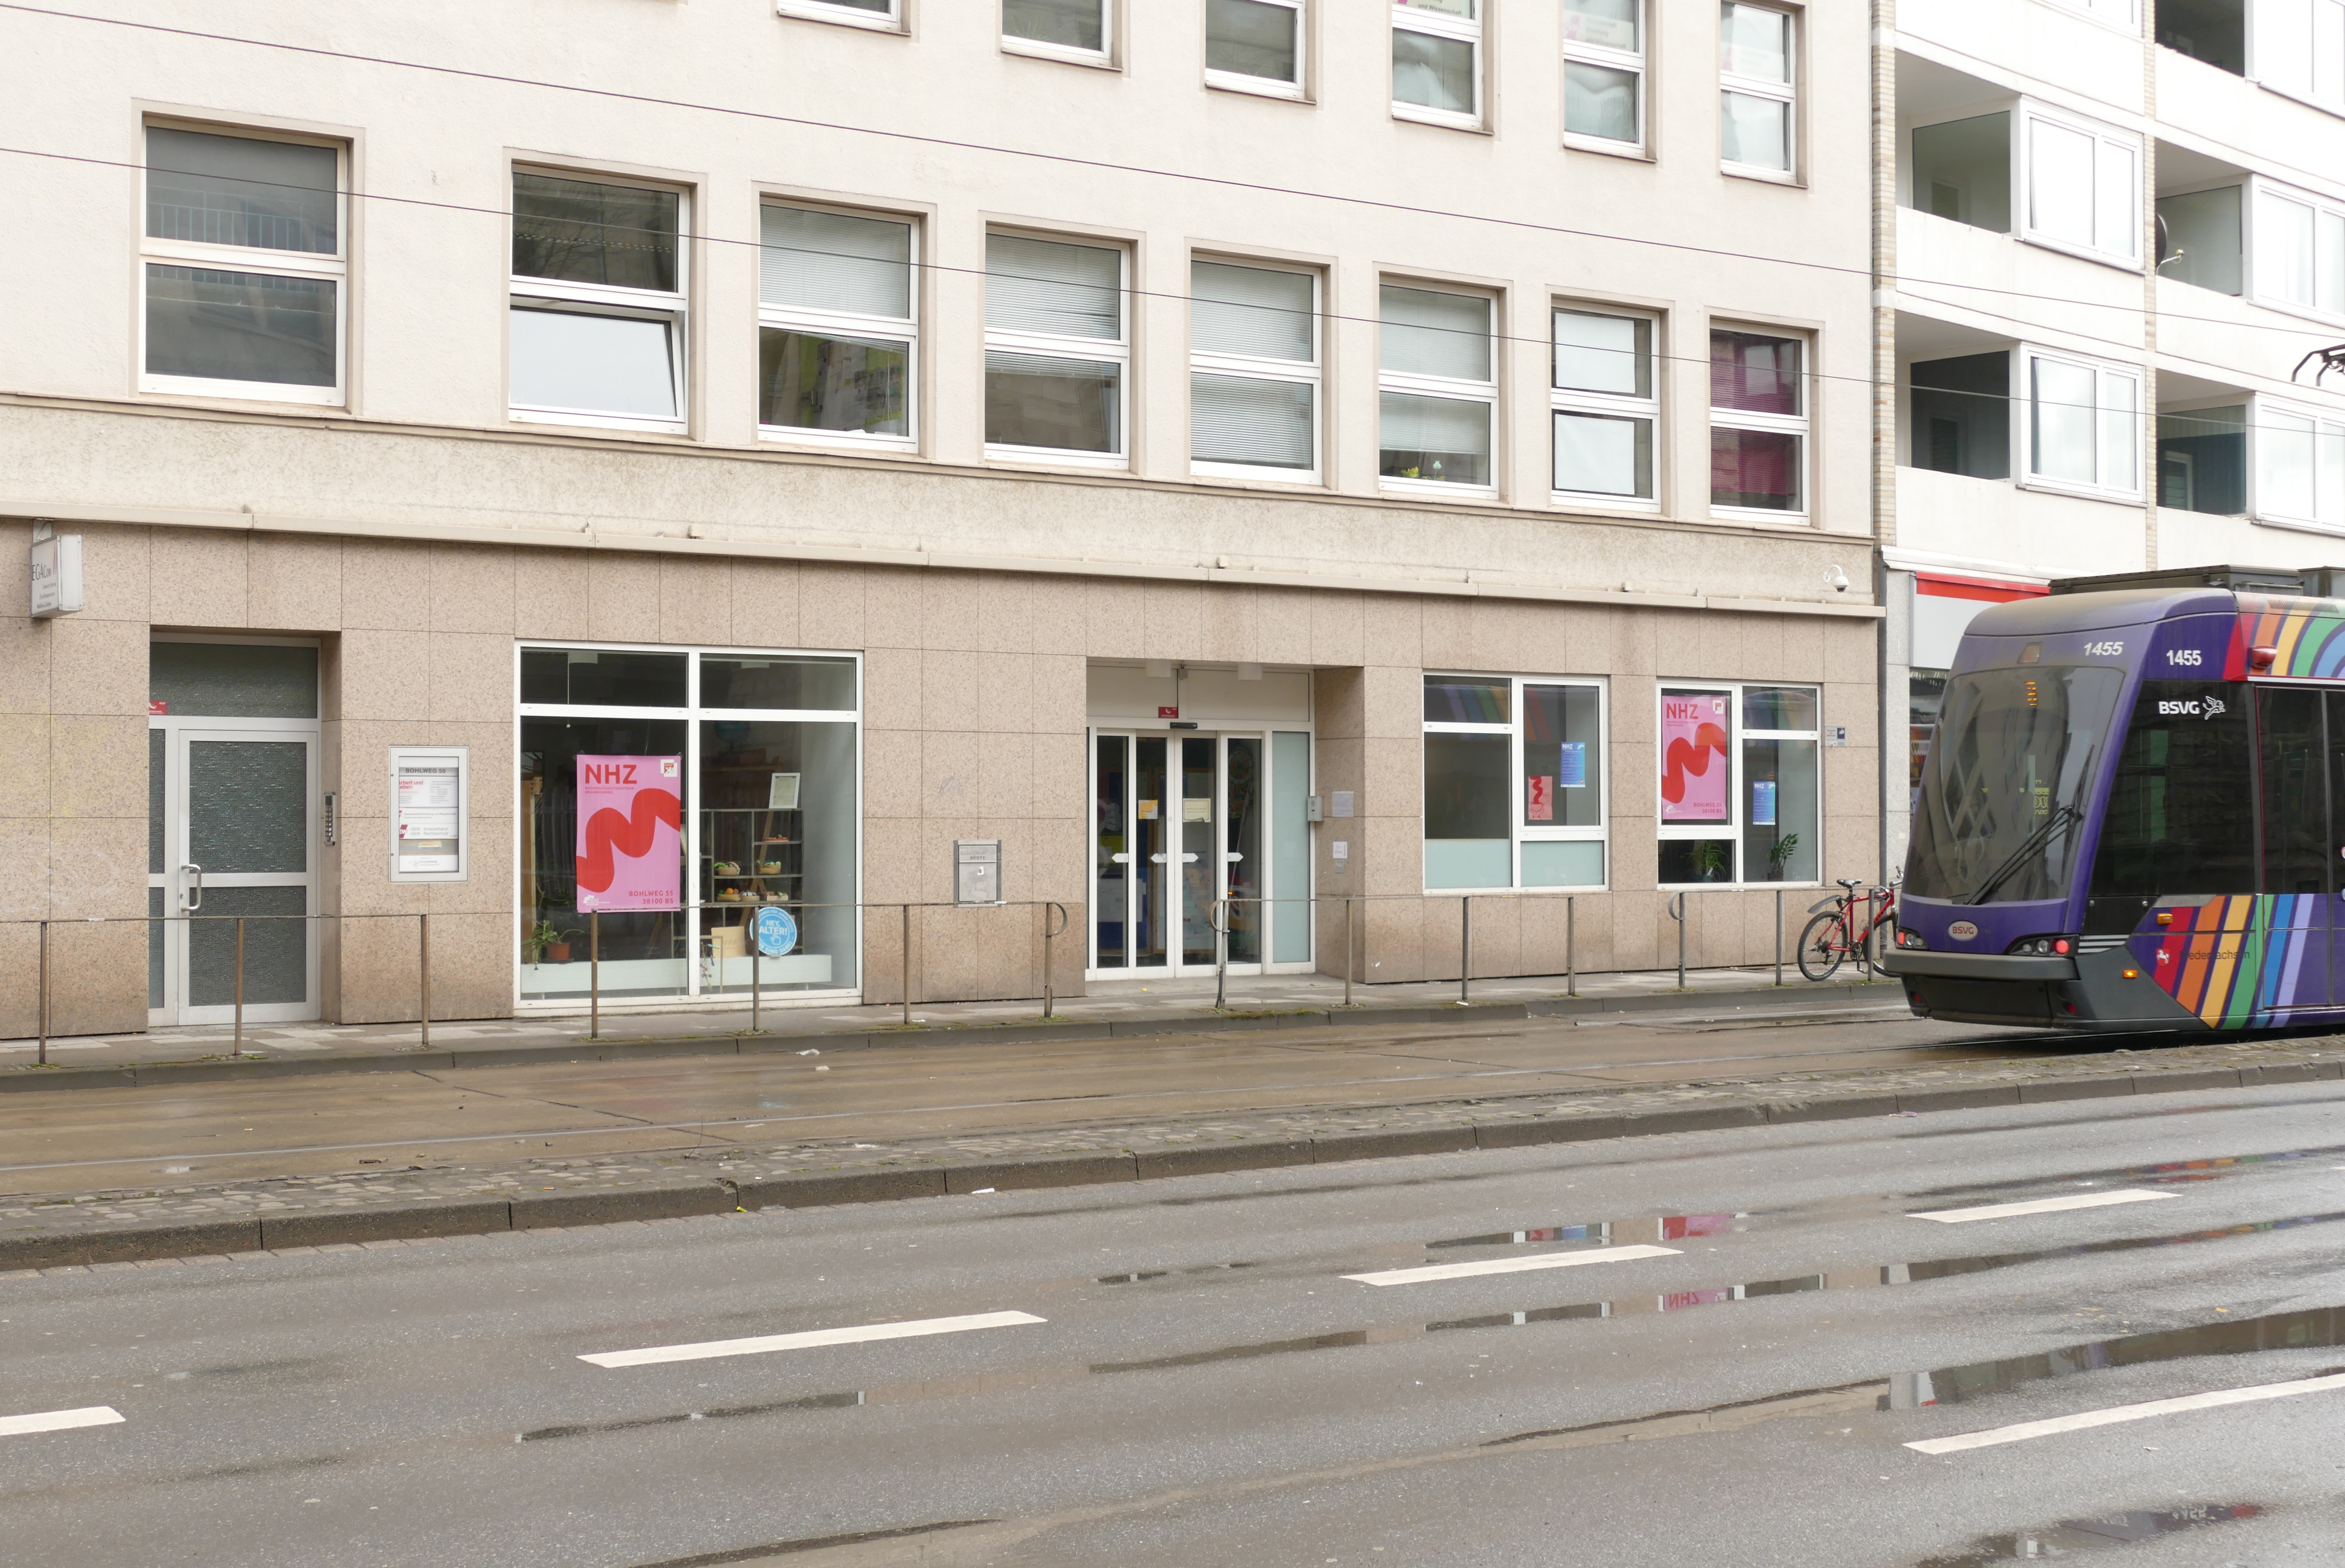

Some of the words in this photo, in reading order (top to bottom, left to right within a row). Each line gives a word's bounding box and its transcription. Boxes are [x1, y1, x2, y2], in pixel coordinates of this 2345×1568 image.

[1429, 5, 1462, 15] Wissenschaft
[2084, 642, 2124, 656] 1455
[2166, 650, 2202, 665] 1455
[1667, 703, 1698, 720] NHZ
[2158, 701, 2200, 714] BSVG
[585, 764, 637, 784] NHZ
[759, 926, 787, 935] ALTER!
